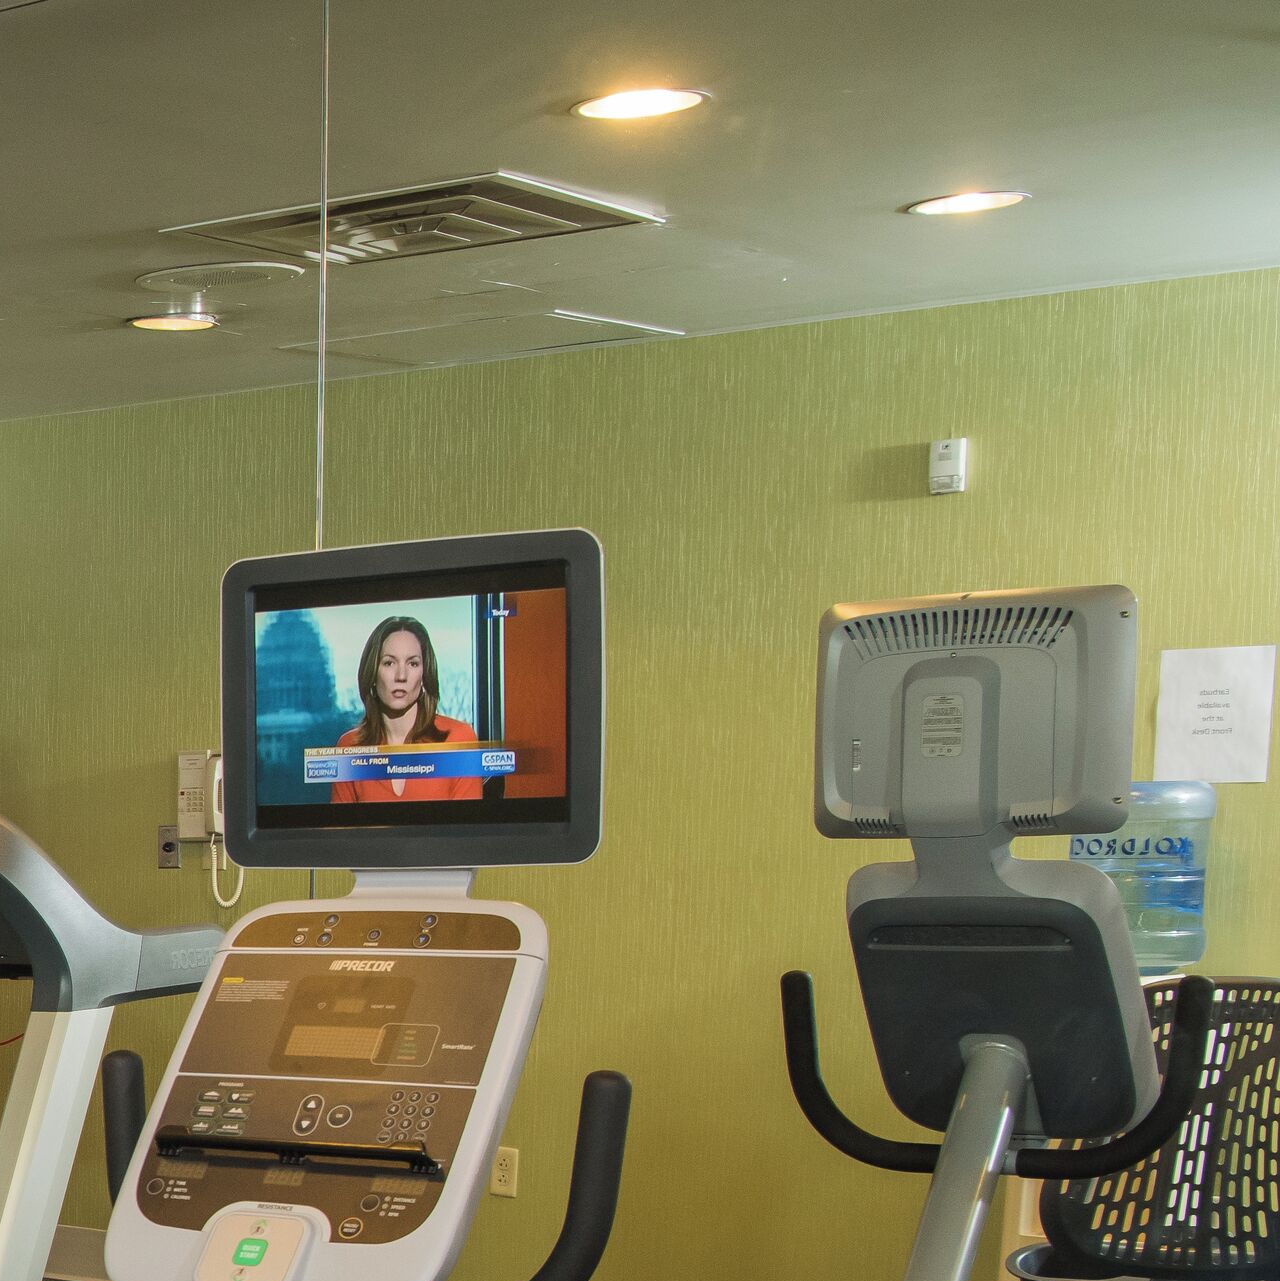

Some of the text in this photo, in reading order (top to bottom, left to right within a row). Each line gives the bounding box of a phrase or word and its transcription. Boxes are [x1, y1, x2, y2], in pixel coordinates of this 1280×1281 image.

[492, 609, 510, 617] Today
[343, 746, 378, 754] CONGRESS
[369, 757, 389, 765] FROM
[308, 769, 337, 777] JOURNAL
[387, 764, 435, 774] Mississippi
[338, 960, 395, 972] PRECOR
[257, 1203, 293, 1211] RESISTANCE
